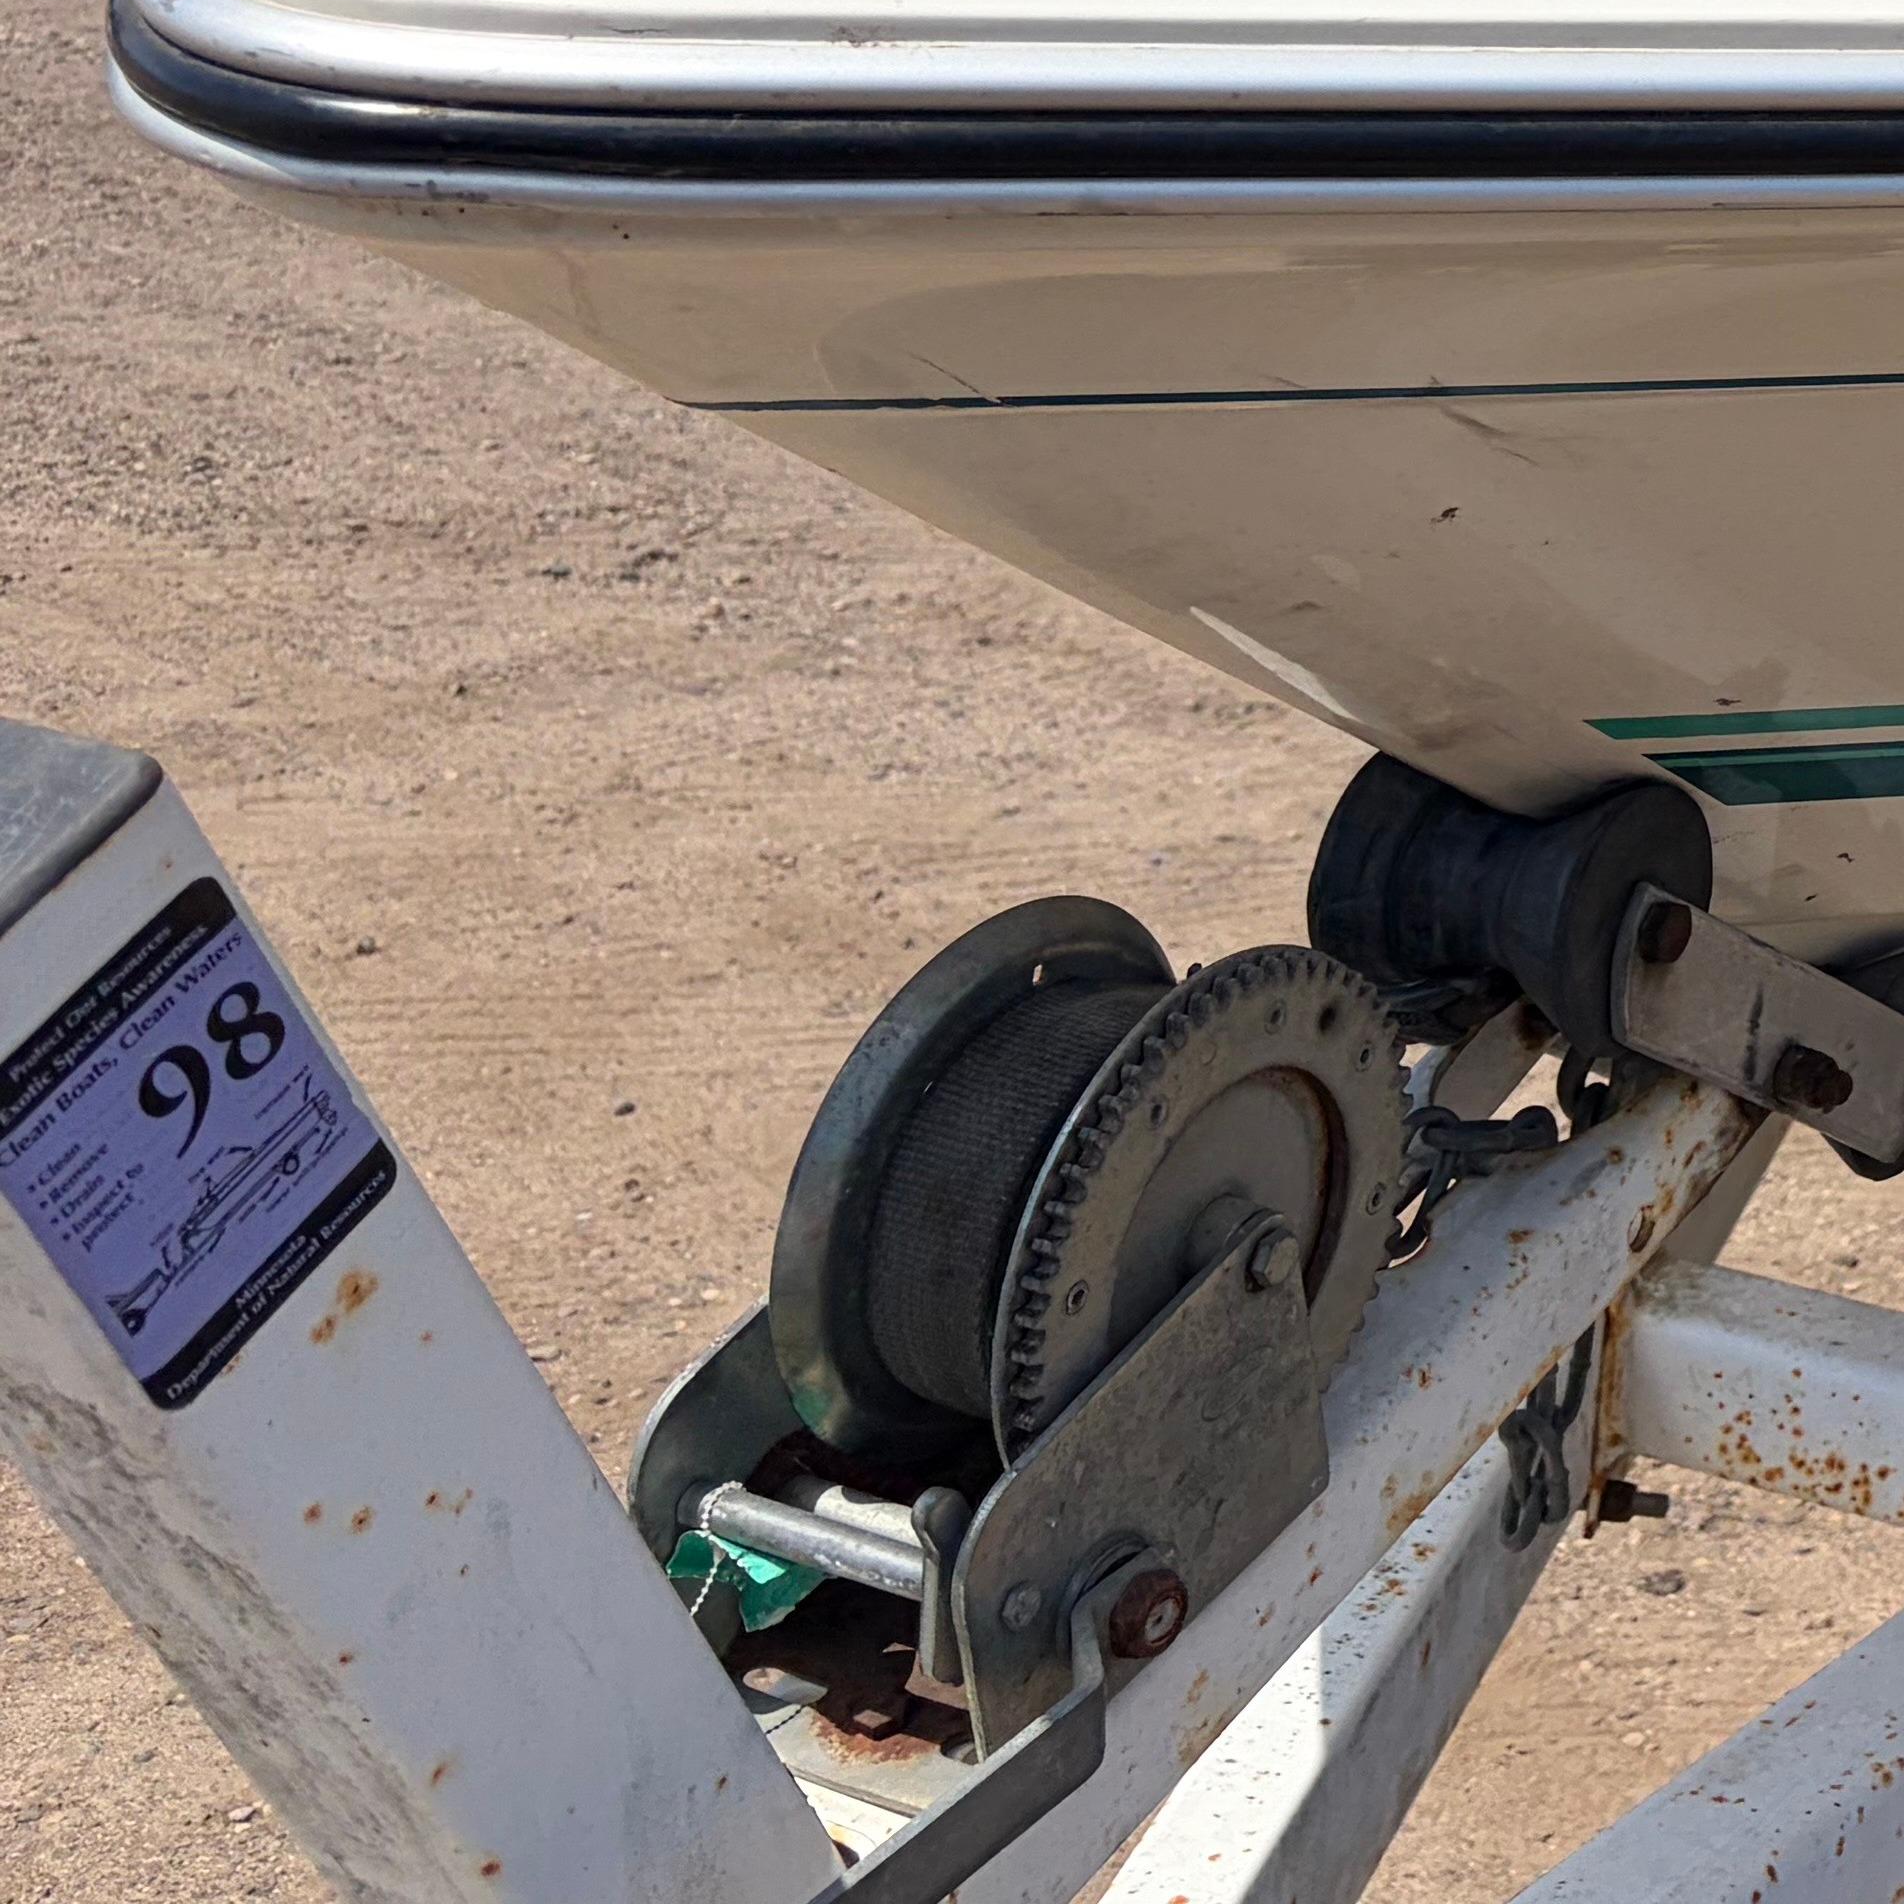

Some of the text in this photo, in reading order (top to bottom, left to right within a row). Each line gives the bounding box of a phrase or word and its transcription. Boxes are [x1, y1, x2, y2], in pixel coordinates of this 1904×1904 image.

[0, 924, 209, 1126] Exotic Species Awareness
[8, 1025, 66, 1082] Protect
[97, 925, 173, 997] Resources
[55, 1056, 119, 1113] Boats,
[119, 995, 177, 1050] Clean
[175, 931, 243, 994] Waters
[138, 981, 286, 1160] 98
[166, 1313, 250, 1400] Department
[251, 1295, 269, 1315] of
[267, 1236, 322, 1296] Natural
[320, 1168, 387, 1240] Resources
[235, 1234, 307, 1309] Minnesota
